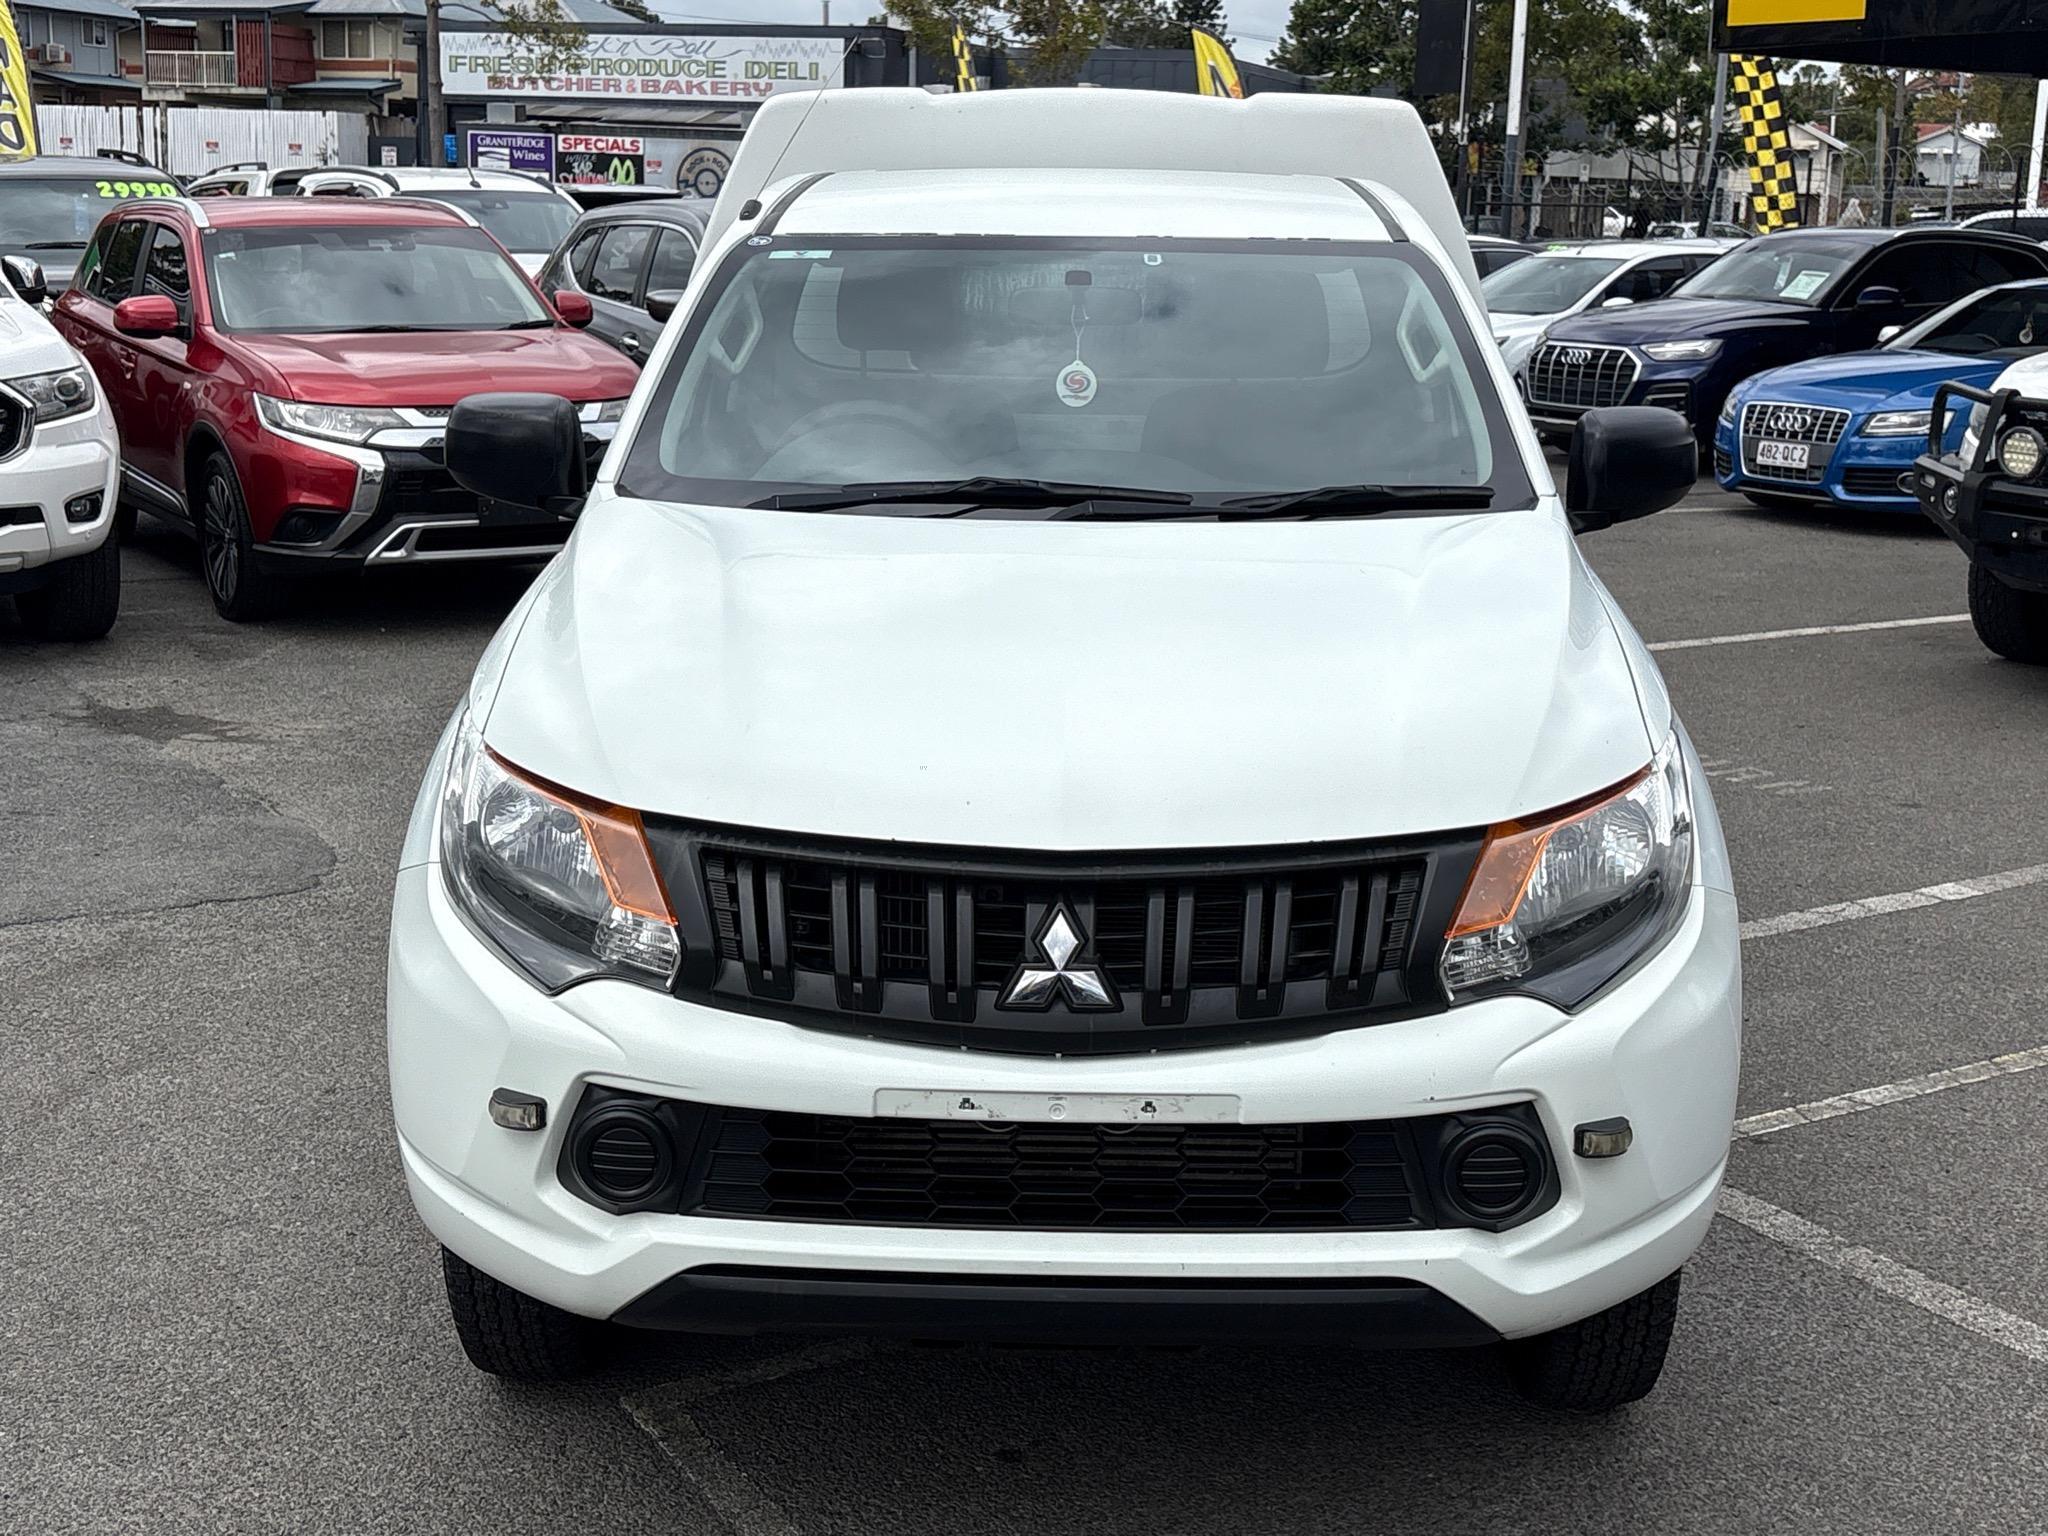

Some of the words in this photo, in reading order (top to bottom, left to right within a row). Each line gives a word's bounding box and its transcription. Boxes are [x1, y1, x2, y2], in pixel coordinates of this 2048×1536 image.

[650, 37, 719, 59] Roll
[487, 75, 622, 93] BUTCHER
[640, 79, 774, 97] BAKERY
[561, 137, 641, 153] SPECIALS
[512, 149, 546, 161] Wines
[95, 181, 177, 198] 29990
